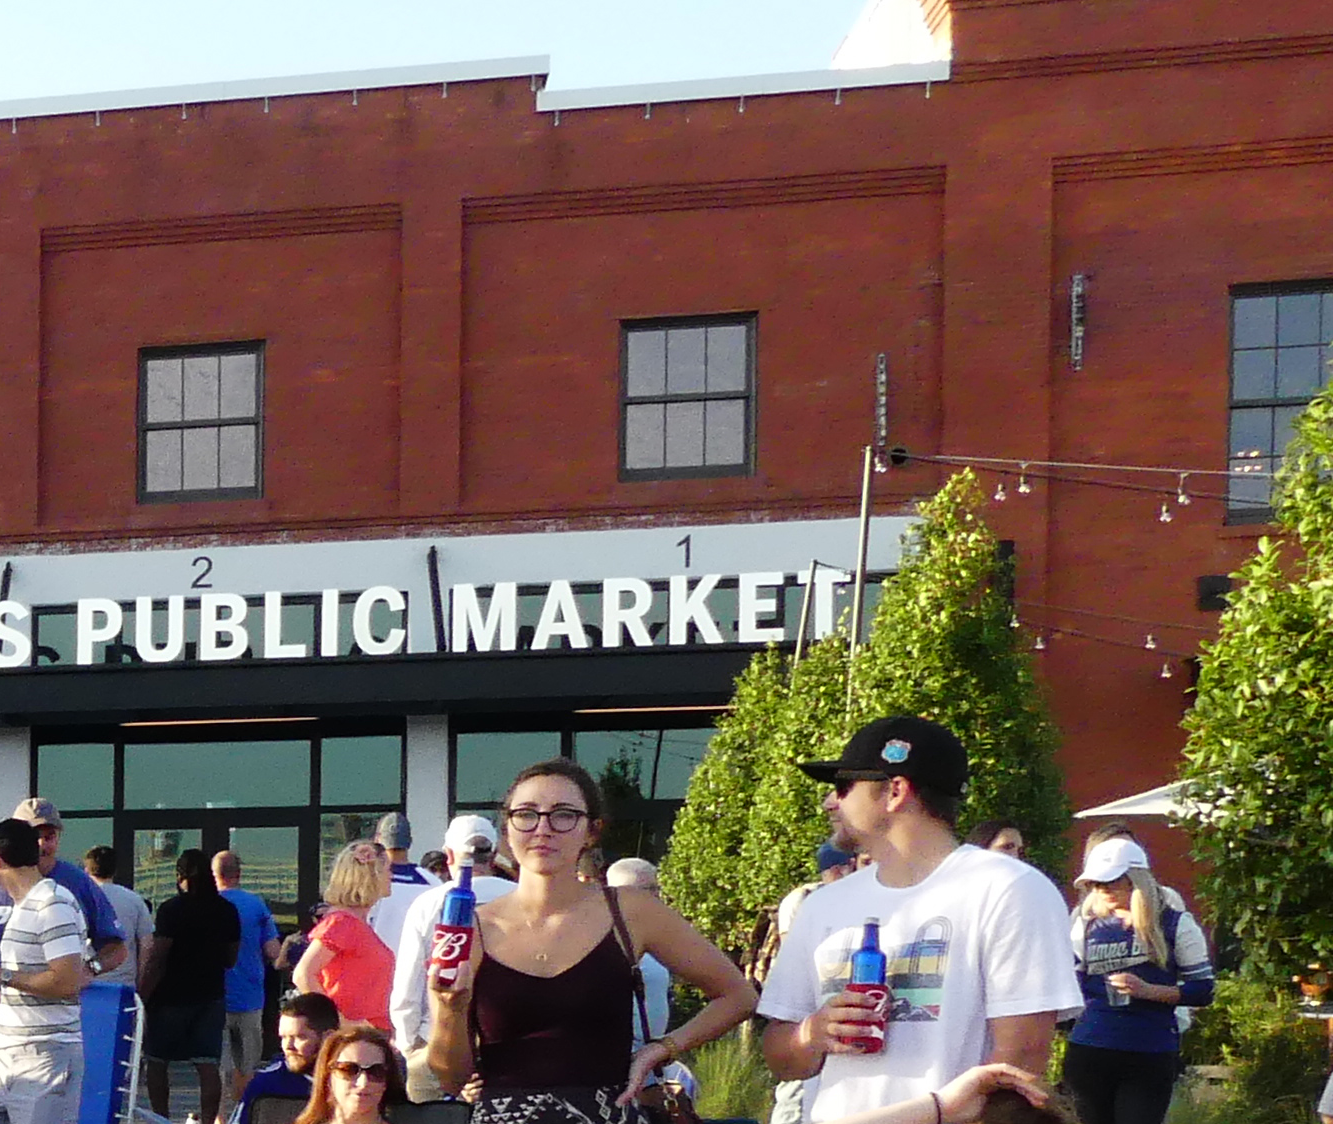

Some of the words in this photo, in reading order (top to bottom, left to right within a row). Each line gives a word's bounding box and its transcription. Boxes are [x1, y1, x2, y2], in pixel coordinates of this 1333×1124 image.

[676, 534, 691, 567] 1
[191, 556, 213, 588] 2
[76, 586, 407, 665] PUBLIC
[452, 569, 851, 654] MARKET
